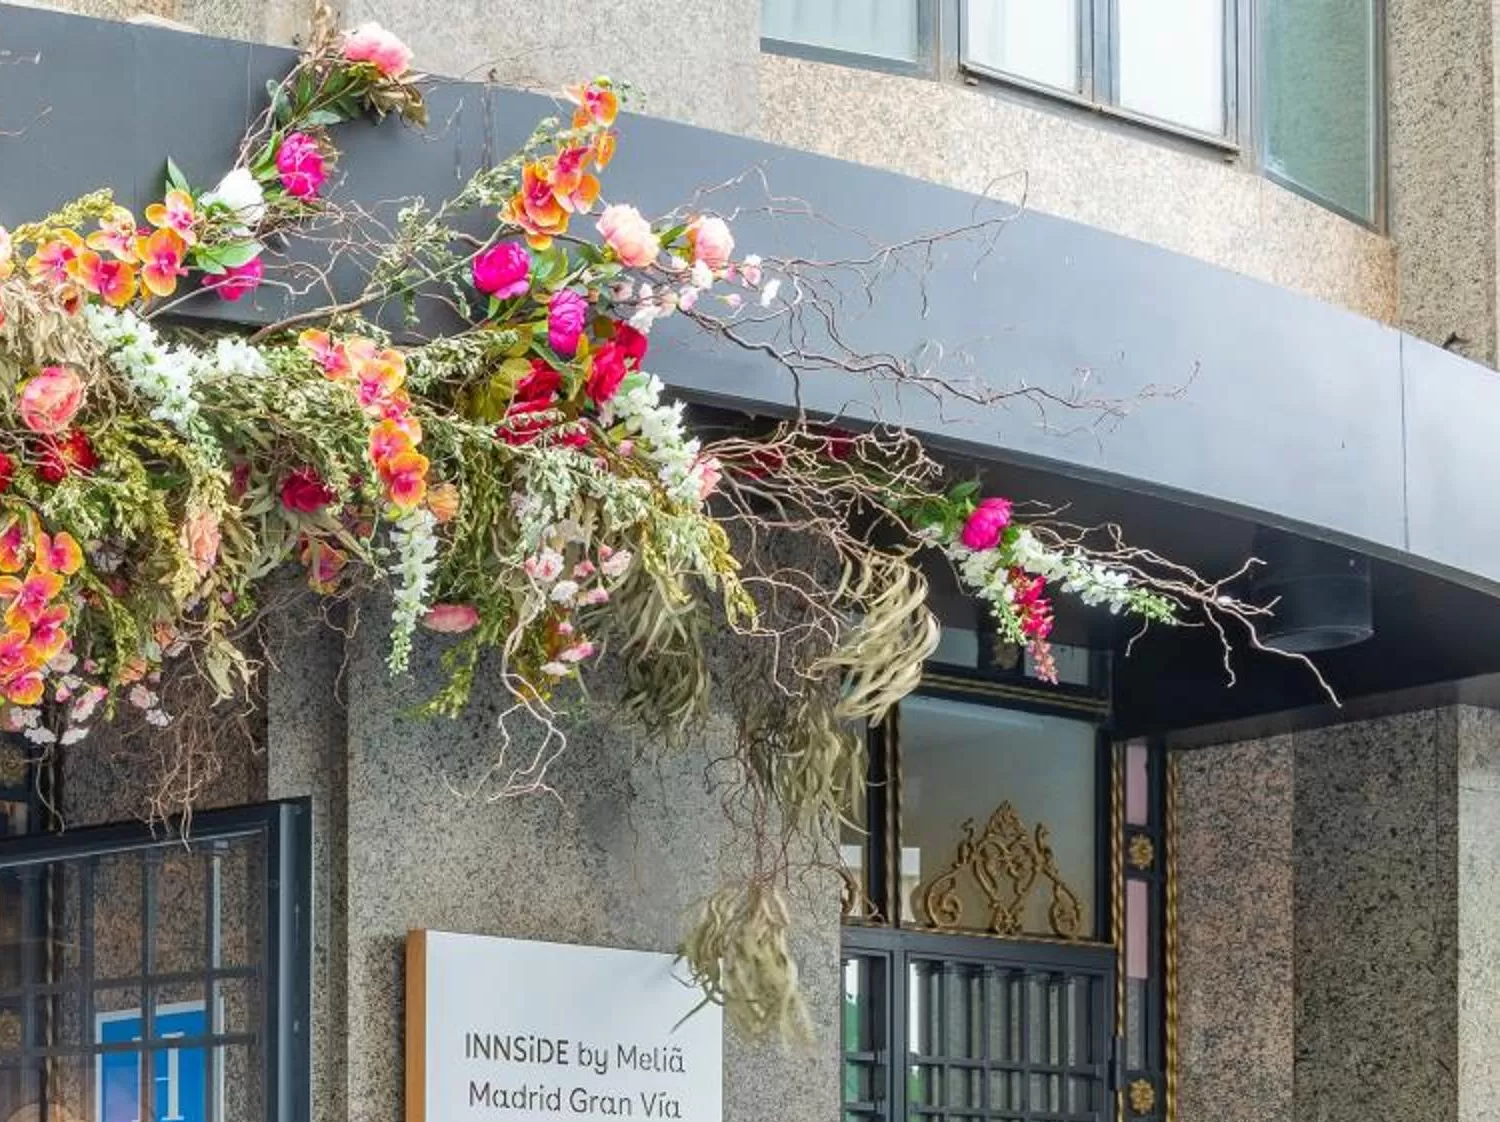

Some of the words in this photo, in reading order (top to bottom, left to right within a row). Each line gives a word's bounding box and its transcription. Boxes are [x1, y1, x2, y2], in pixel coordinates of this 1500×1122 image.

[577, 1041, 608, 1076] by
[469, 1080, 561, 1112] Madrid
[569, 1087, 632, 1116] Gran
[640, 1091, 682, 1119] Vía
